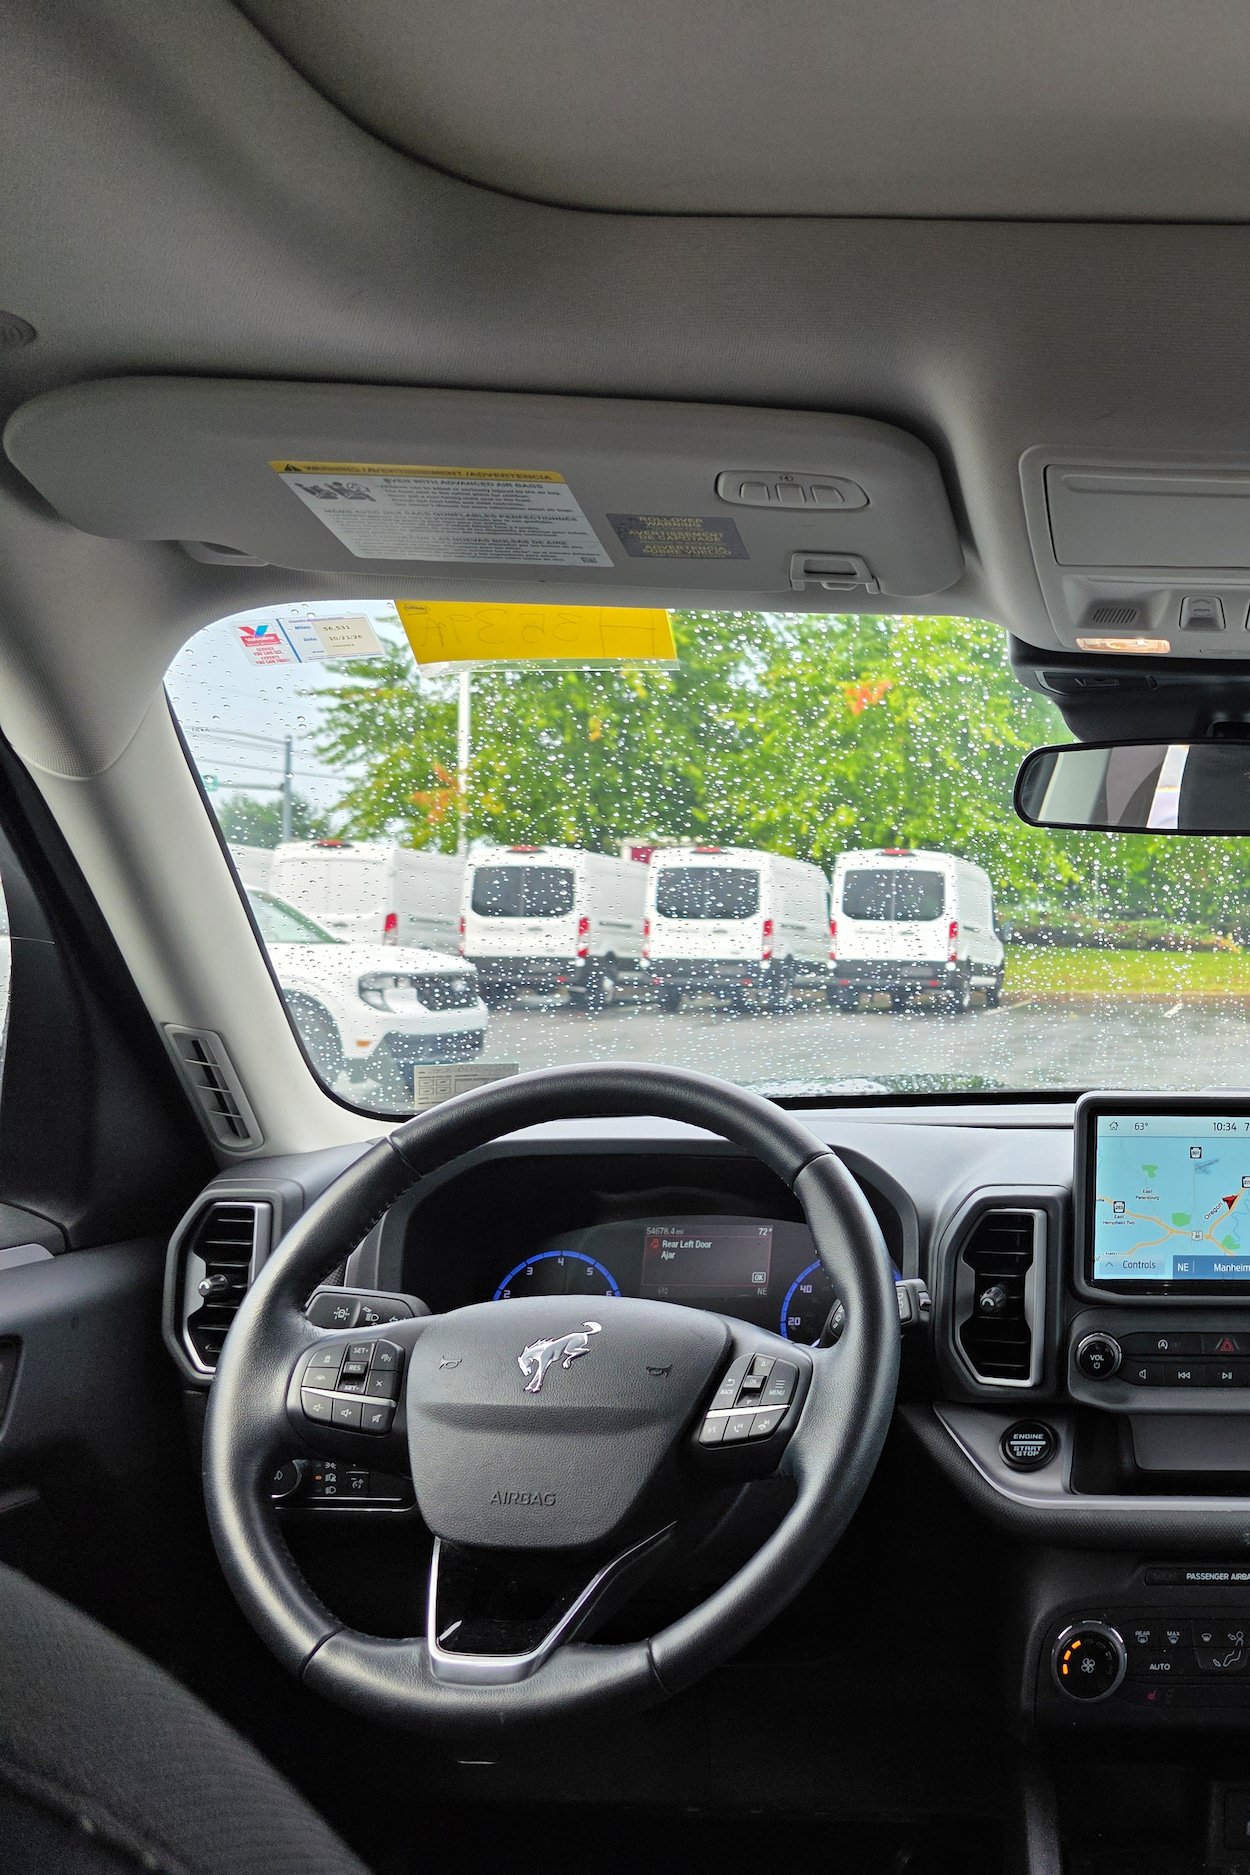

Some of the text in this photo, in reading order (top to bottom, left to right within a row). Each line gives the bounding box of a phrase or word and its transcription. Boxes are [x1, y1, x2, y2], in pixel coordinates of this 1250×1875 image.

[1134, 1122, 1149, 1131] 63°
[1212, 1122, 1237, 1132] 10:34
[1204, 1201, 1224, 1220] Oregon
[661, 1240, 713, 1249] Rear Left Door
[660, 1250, 676, 1261] Ajar
[557, 1257, 565, 1266] 4
[1122, 1259, 1156, 1270] Controls
[526, 1266, 534, 1276] 3
[586, 1266, 594, 1276] 5
[1177, 1263, 1189, 1272] NE
[1213, 1263, 1250, 1272] Manheim
[754, 1273, 765, 1282] OK
[503, 1289, 511, 1298] 2
[756, 1287, 768, 1296] NE
[799, 1284, 813, 1294] 40
[787, 1316, 801, 1326] 20
[1089, 1353, 1105, 1362] VOL
[348, 1364, 361, 1372] RES
[719, 1388, 735, 1396] BACK
[768, 1389, 786, 1397] MENU
[490, 1490, 557, 1507] AIRBAG
[1185, 1572, 1230, 1581] PASSENGER
[1149, 1663, 1171, 1671] AUTO
